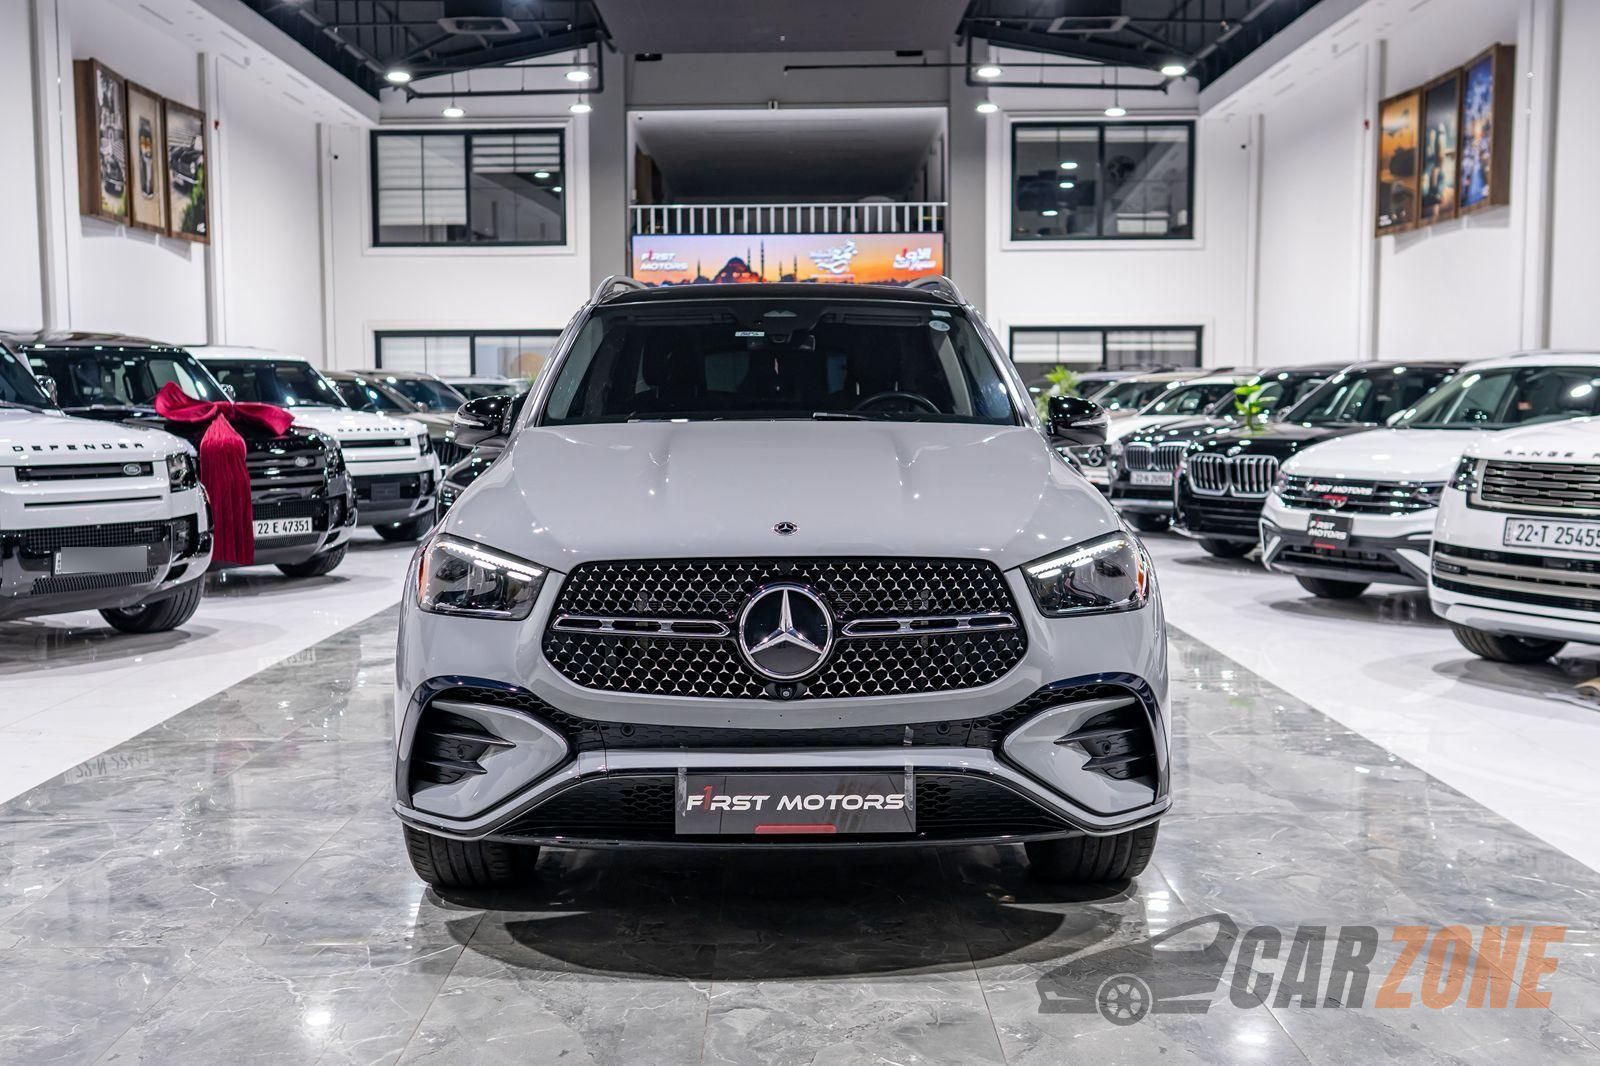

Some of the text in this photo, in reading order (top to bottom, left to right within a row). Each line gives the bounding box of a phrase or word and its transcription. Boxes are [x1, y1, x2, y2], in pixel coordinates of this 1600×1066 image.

[640, 262, 688, 271] MOTORS
[12, 443, 144, 452] DEFENDER
[1331, 486, 1373, 495] MOTORS
[257, 520, 309, 534] 22 E 47351
[1308, 529, 1347, 540] MOTORS
[776, 794, 905, 810] MOTORS
